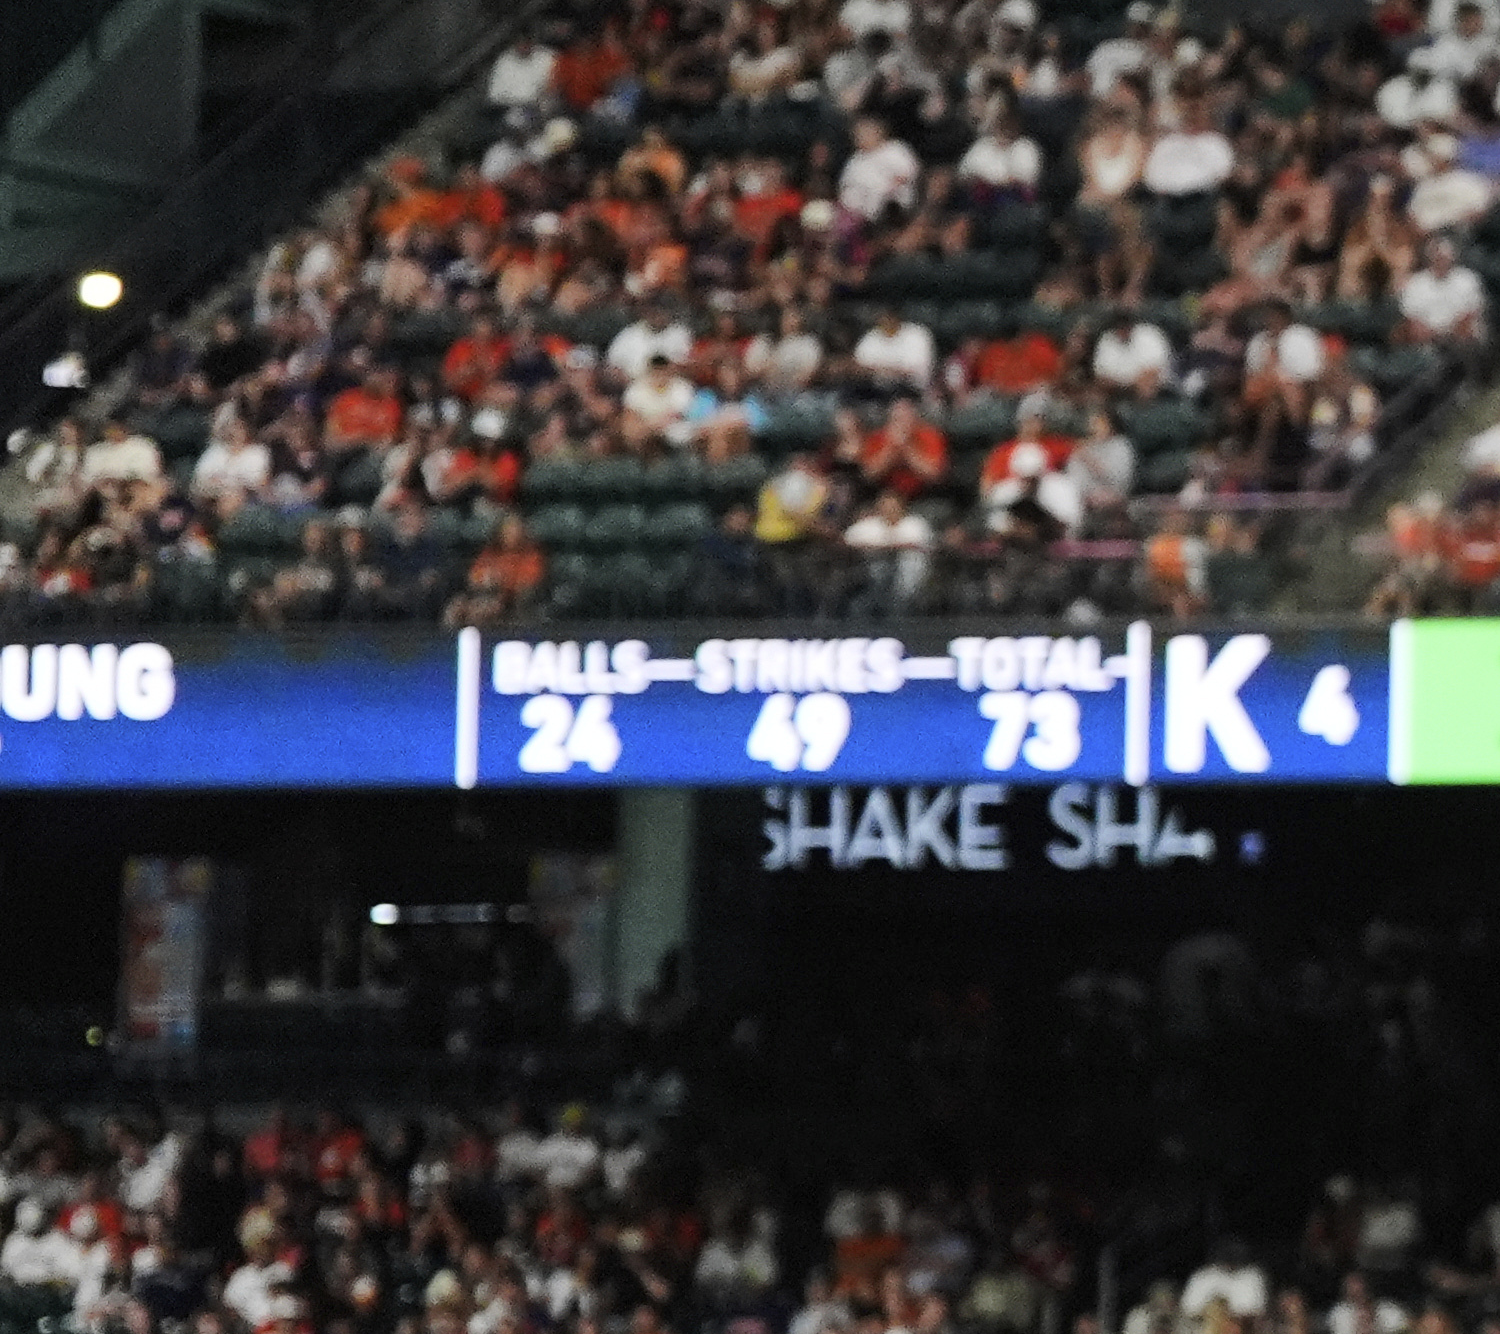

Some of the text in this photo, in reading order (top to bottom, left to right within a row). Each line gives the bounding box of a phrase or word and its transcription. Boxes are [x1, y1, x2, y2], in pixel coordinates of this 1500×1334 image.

[0, 642, 176, 722] UNG
[492, 636, 1113, 695] BALLS STRIKES TOTAL
[1163, 633, 1360, 774] K 4
[518, 690, 1083, 774] 24 49 73
